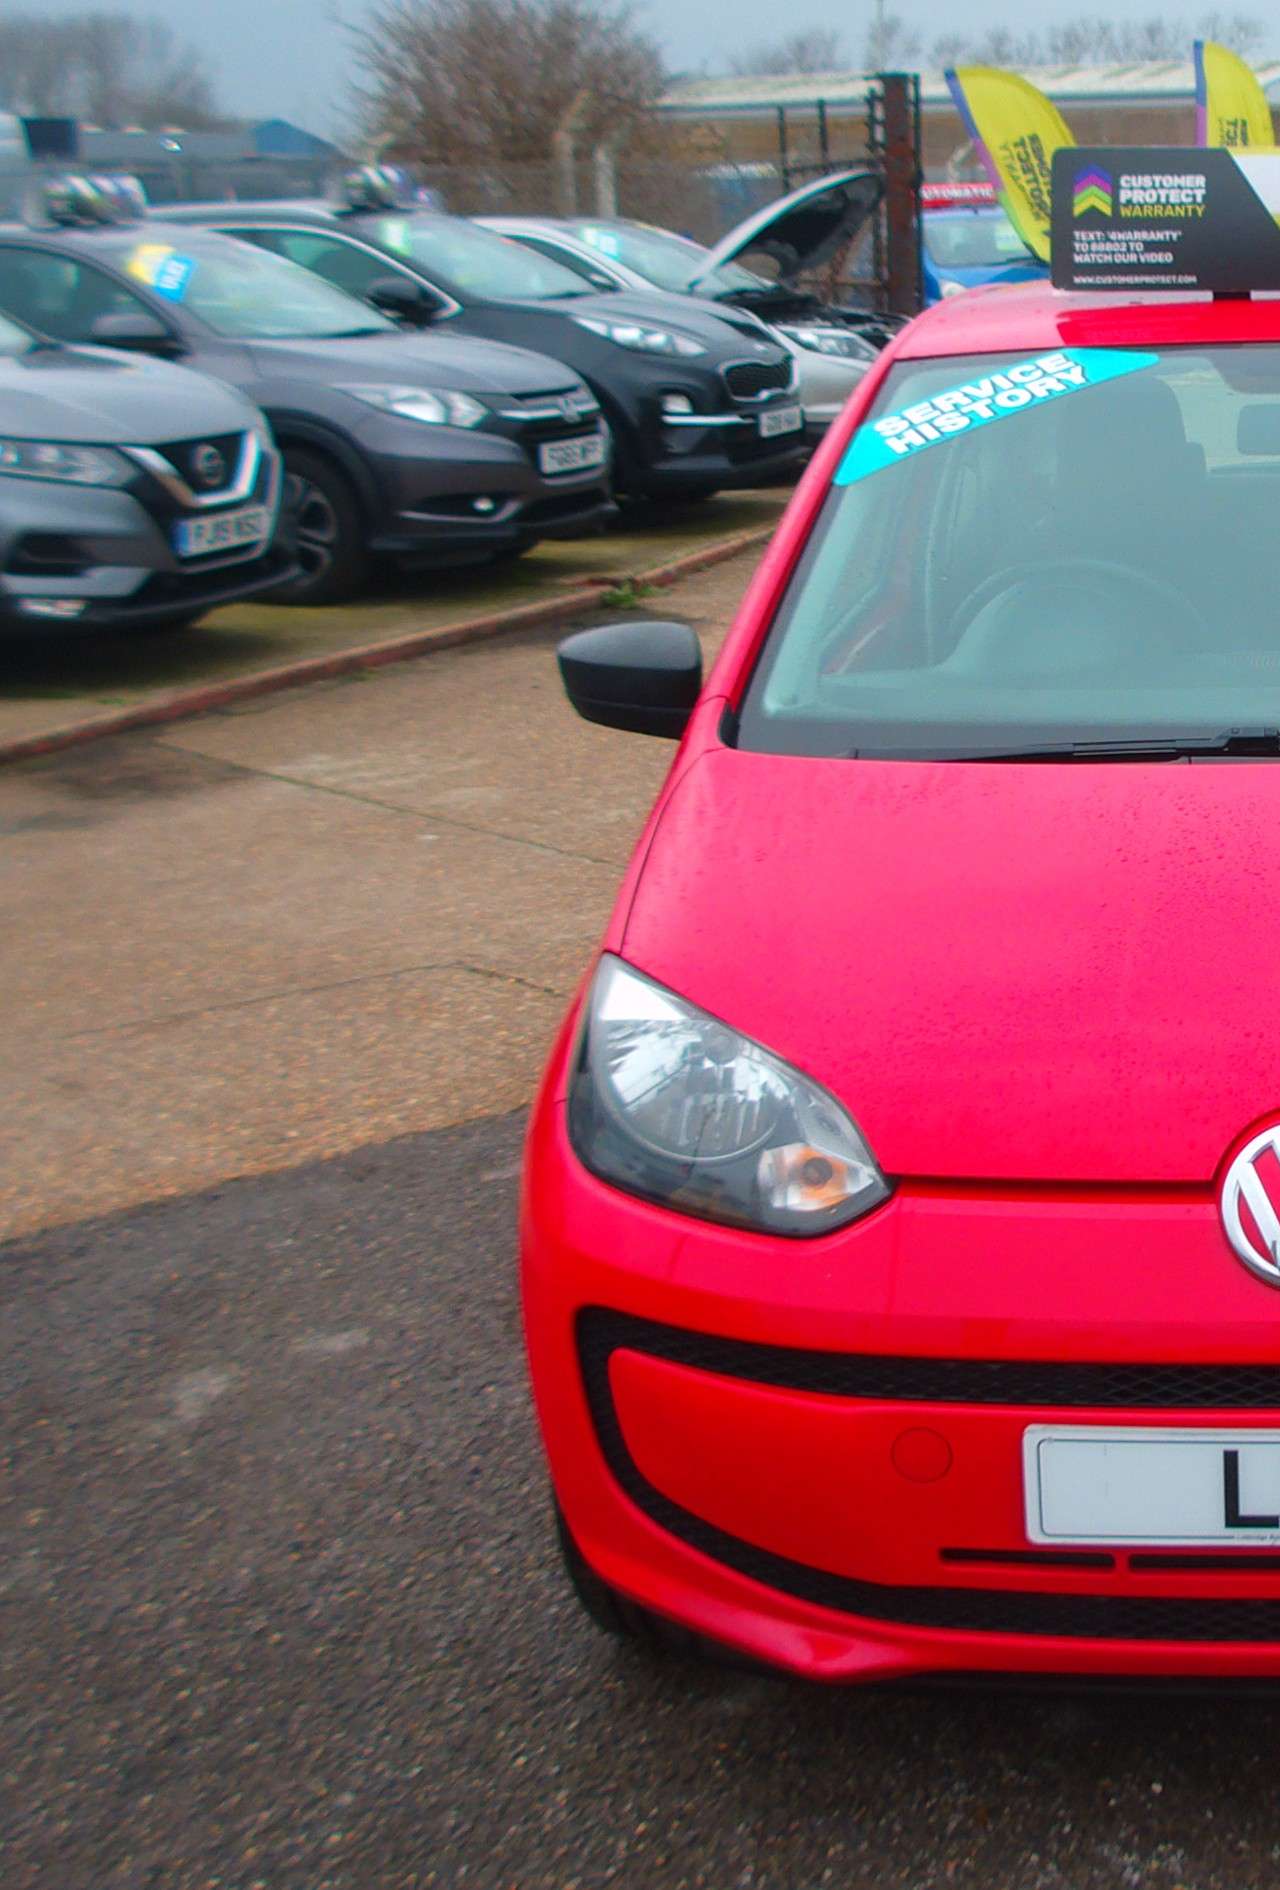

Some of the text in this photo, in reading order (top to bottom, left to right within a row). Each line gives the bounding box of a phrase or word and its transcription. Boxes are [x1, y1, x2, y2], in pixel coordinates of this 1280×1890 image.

[1119, 174, 1207, 189] CUSTOMER
[1119, 188, 1207, 204] PROTECT
[1120, 204, 1206, 218] WARRANTY
[1074, 242, 1088, 252] TO
[1129, 242, 1144, 252] TO
[1073, 252, 1174, 263] WATCH OUR VIDEO
[874, 352, 1076, 436] SERVICE
[885, 365, 1088, 454] HISTORY
